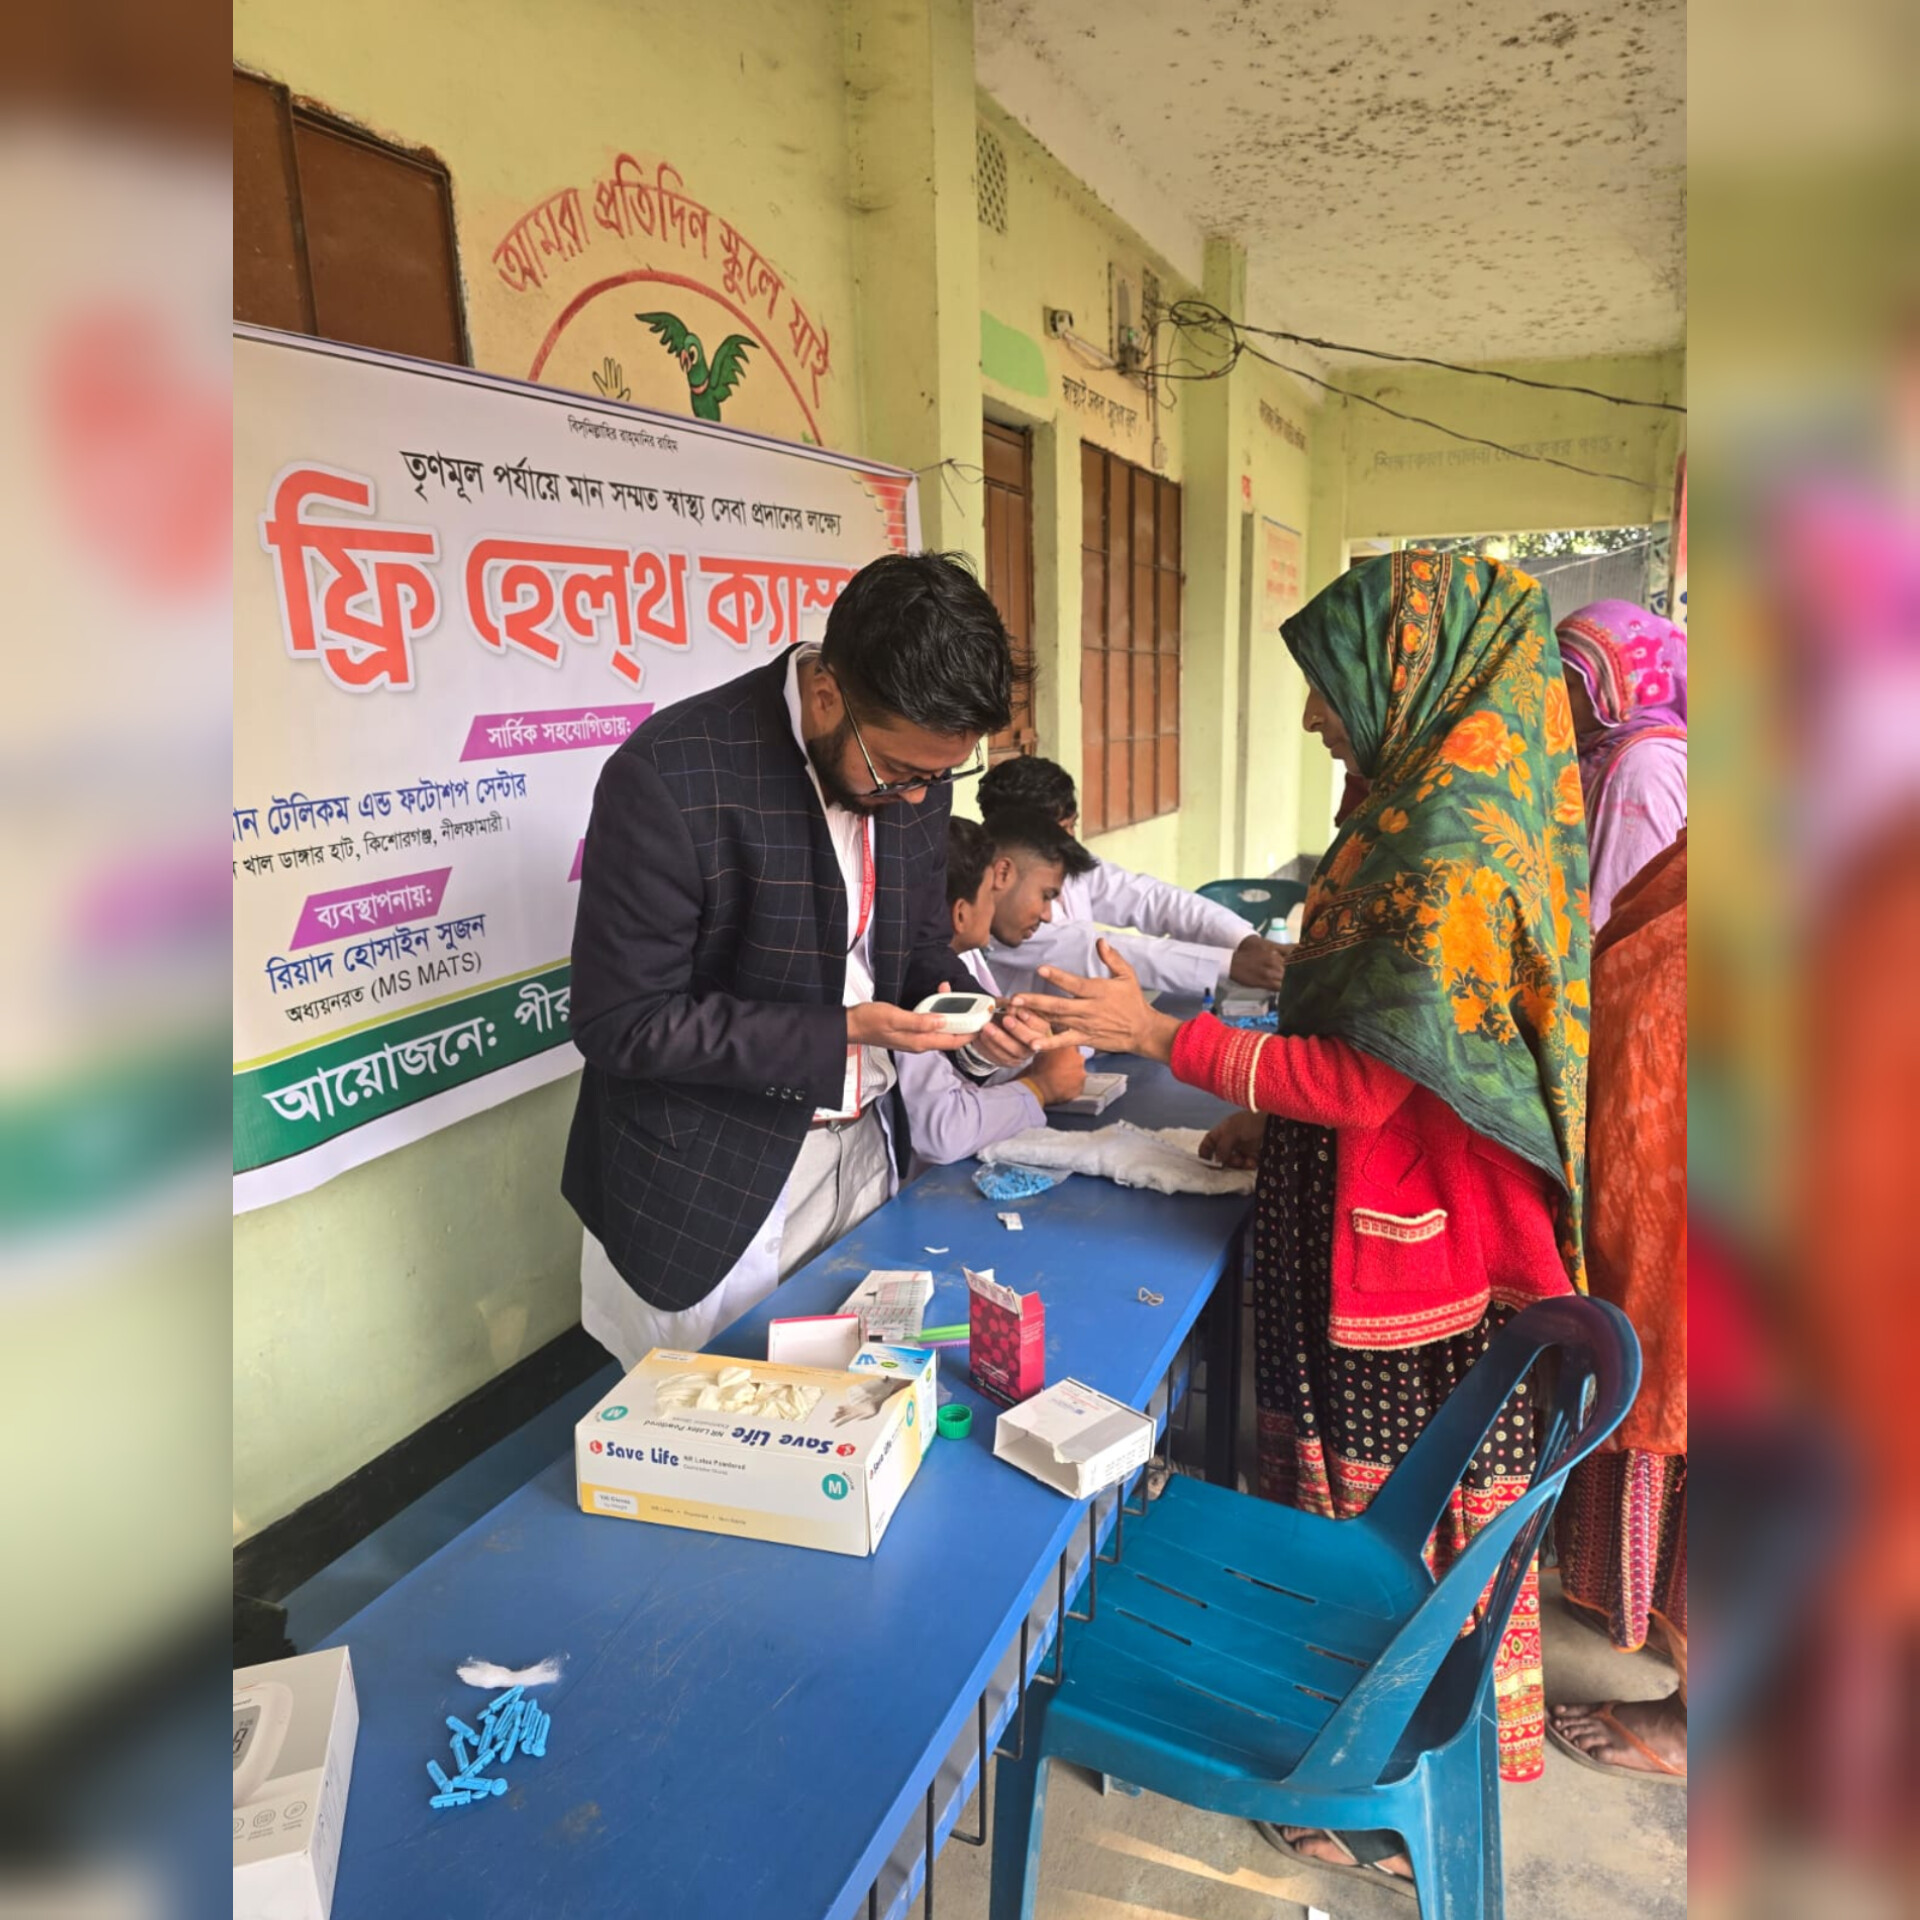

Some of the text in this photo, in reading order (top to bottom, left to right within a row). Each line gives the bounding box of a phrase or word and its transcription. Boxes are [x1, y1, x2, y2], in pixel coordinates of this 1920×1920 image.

[492, 153, 830, 409] আমরা প্রতিদিন স্কুলে যাই
[399, 450, 841, 537] তৃণমূল পর্যায়ে মান সম্মত স্বাস্থ্য সেবা প্রদানের লক্ষ্যে
[264, 468, 437, 686] ফ্রি
[486, 717, 538, 750] সার্বিক
[233, 770, 527, 842] ান টেলিকম এন্ড ফটোশপ সেন্টার
[243, 853, 274, 877] খাল
[279, 844, 324, 872] ডাঙ্গার
[330, 836, 361, 862] হাট,
[363, 828, 438, 856] কিশোরগঞ্জ,
[265, 914, 486, 995] রিয়াদ হোসাইন সুজন
[285, 951, 482, 1024] অধ্যয়নরত (MS MATS)
[606, 1441, 645, 1461] Save
[651, 1447, 680, 1467] Life
[731, 1427, 771, 1447] Life
[778, 1435, 834, 1454] Save
[828, 1480, 842, 1495] M
